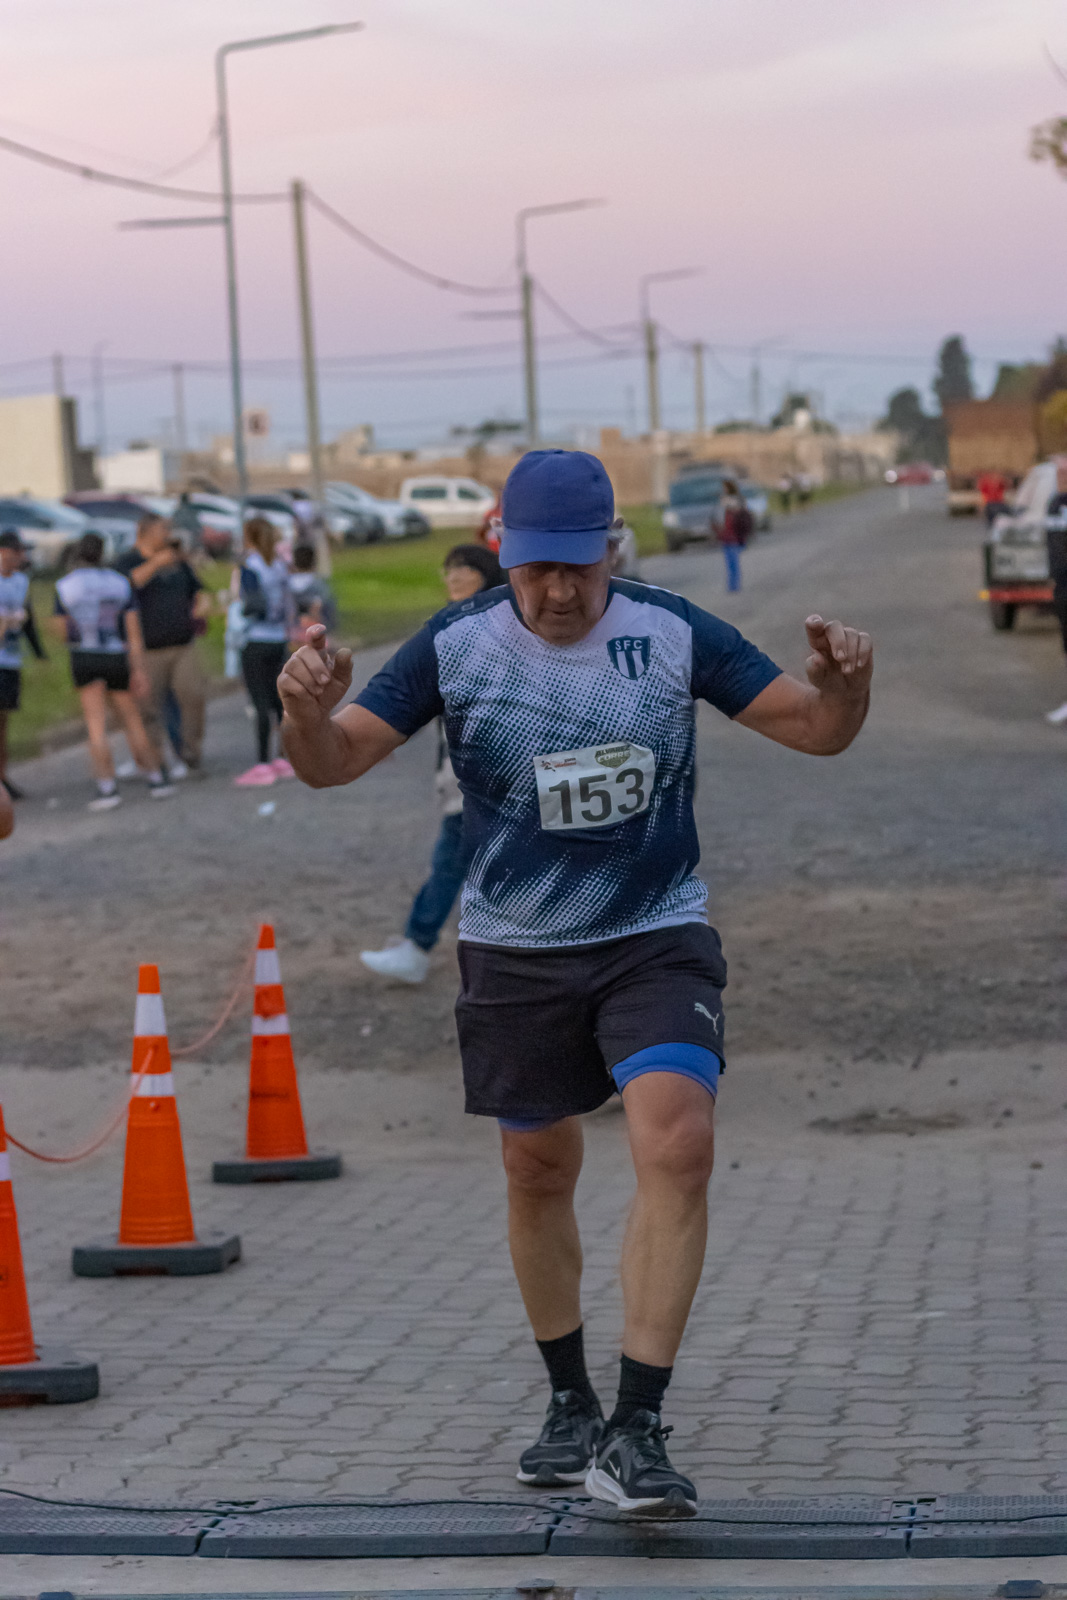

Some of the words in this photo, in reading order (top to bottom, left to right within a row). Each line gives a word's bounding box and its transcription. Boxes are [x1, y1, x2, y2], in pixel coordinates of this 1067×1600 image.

[615, 639, 643, 651] SFC
[595, 744, 631, 757] ALVAREZ
[597, 750, 631, 763] CORRE
[548, 767, 645, 825] 153
